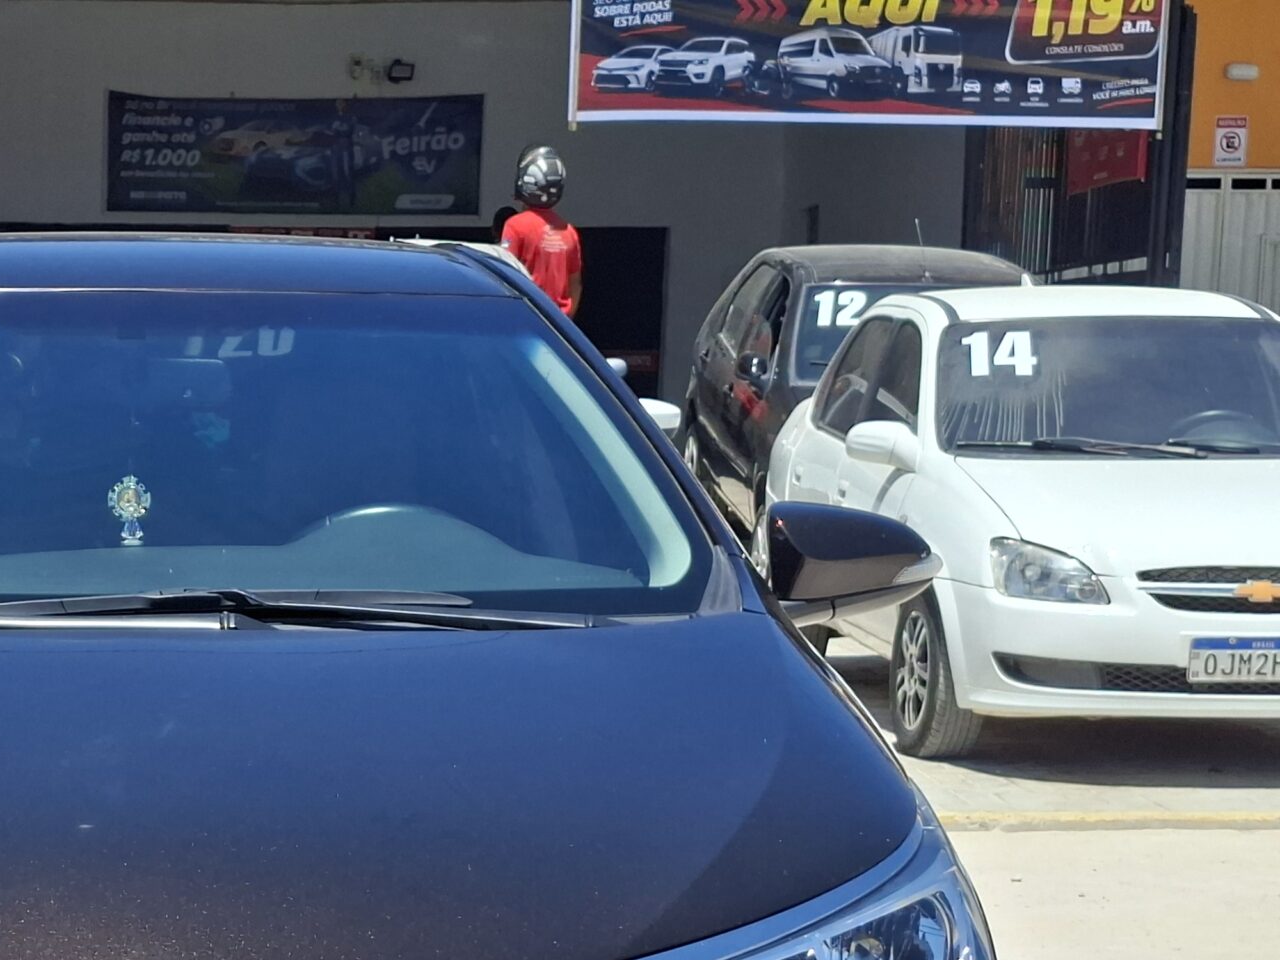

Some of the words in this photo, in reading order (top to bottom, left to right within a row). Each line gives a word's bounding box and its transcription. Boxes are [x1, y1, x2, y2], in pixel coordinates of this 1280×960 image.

[594, 3, 630, 18] SOBRE
[1121, 19, 1155, 34] a.m.
[381, 127, 465, 160] Feirão
[143, 148, 201, 167] 1.000
[814, 290, 869, 327] 12
[960, 331, 1038, 376] 14
